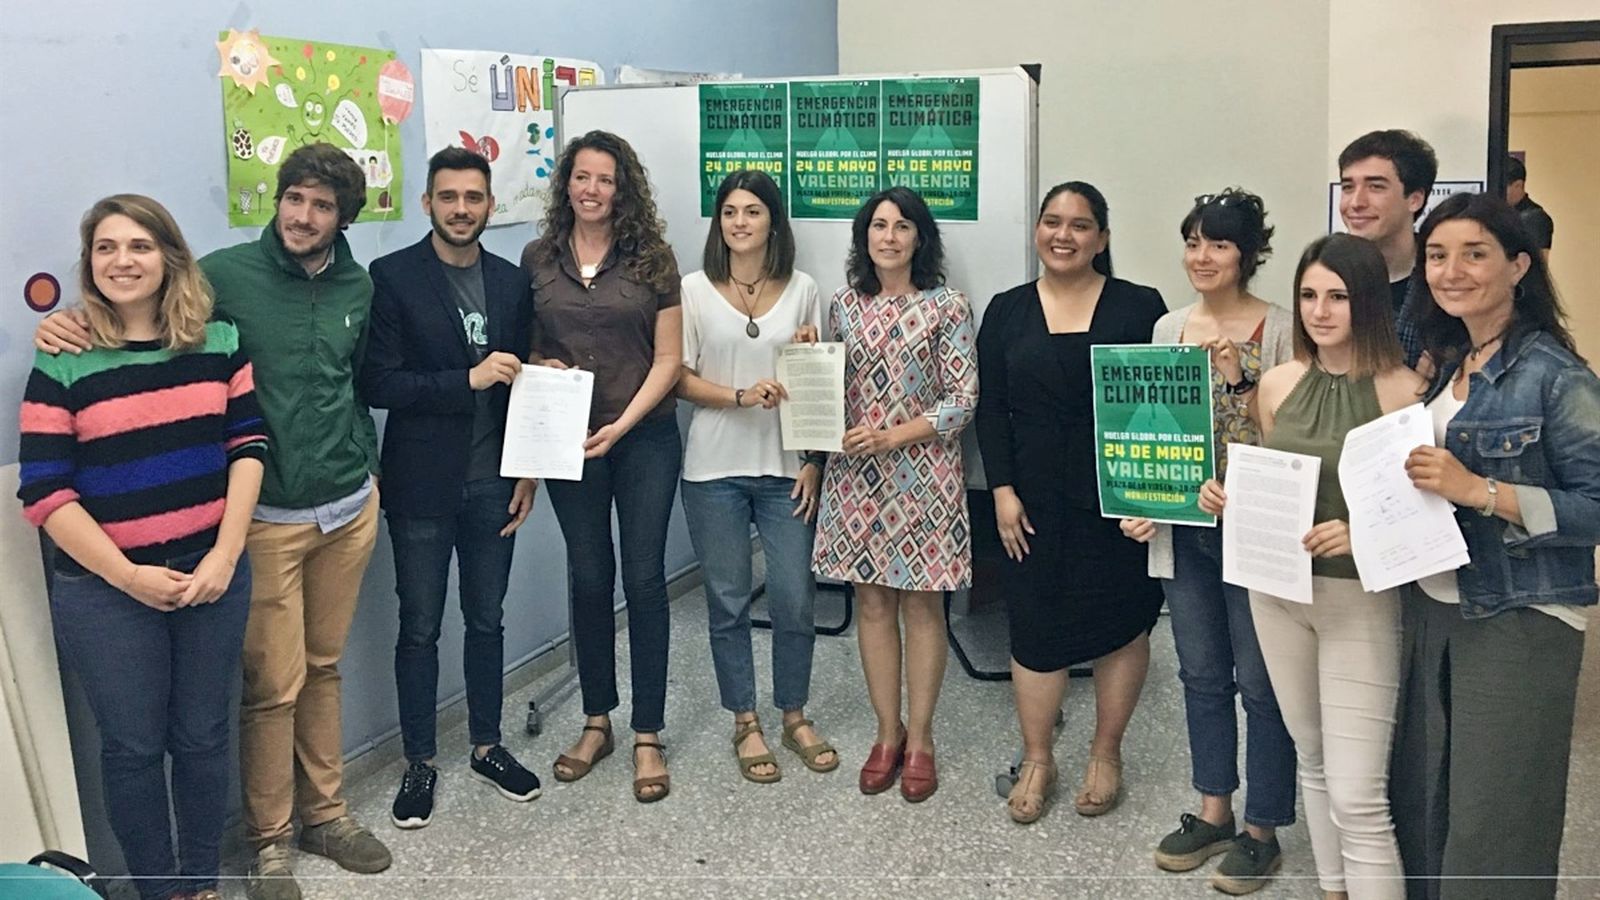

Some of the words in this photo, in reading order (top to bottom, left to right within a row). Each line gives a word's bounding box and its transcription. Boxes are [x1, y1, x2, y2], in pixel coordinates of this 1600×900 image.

[453, 59, 478, 93] Sé
[706, 99, 782, 111] EMERGENCIA
[797, 96, 877, 110] EMERGENCIA
[889, 94, 973, 107] EMERGENCIA
[707, 113, 781, 129] CLIMÁTICA
[798, 111, 876, 128] CLIMÁTICA
[890, 108, 972, 126] CLIMÁTICA
[706, 161, 722, 172] 24
[726, 161, 741, 172] DE
[746, 161, 782, 173] MAYO
[796, 160, 813, 172] 24
[817, 160, 834, 172] DE
[839, 160, 876, 172] MAYO
[887, 159, 905, 171] 24
[910, 159, 928, 171] DE
[932, 159, 972, 171] MAYO
[797, 174, 875, 188] VALENCIA
[889, 174, 970, 188] VALENCIA
[812, 197, 860, 206] MANIFESTACIÓN
[1101, 365, 1201, 382] EMERGENCIA
[1104, 382, 1201, 405] CLIMÁTICA
[1104, 431, 1130, 440] HUELGA
[1131, 432, 1157, 441] GLOBAL
[1158, 433, 1172, 442] POR
[1173, 434, 1182, 442] EL
[1183, 434, 1205, 443] CLIMA
[1104, 443, 1125, 458] 24
[1130, 444, 1151, 459] DE
[1156, 445, 1205, 461] MAYO
[1106, 461, 1203, 482] VALENCIA
[1124, 490, 1186, 503] MANIFESTACIÓN
